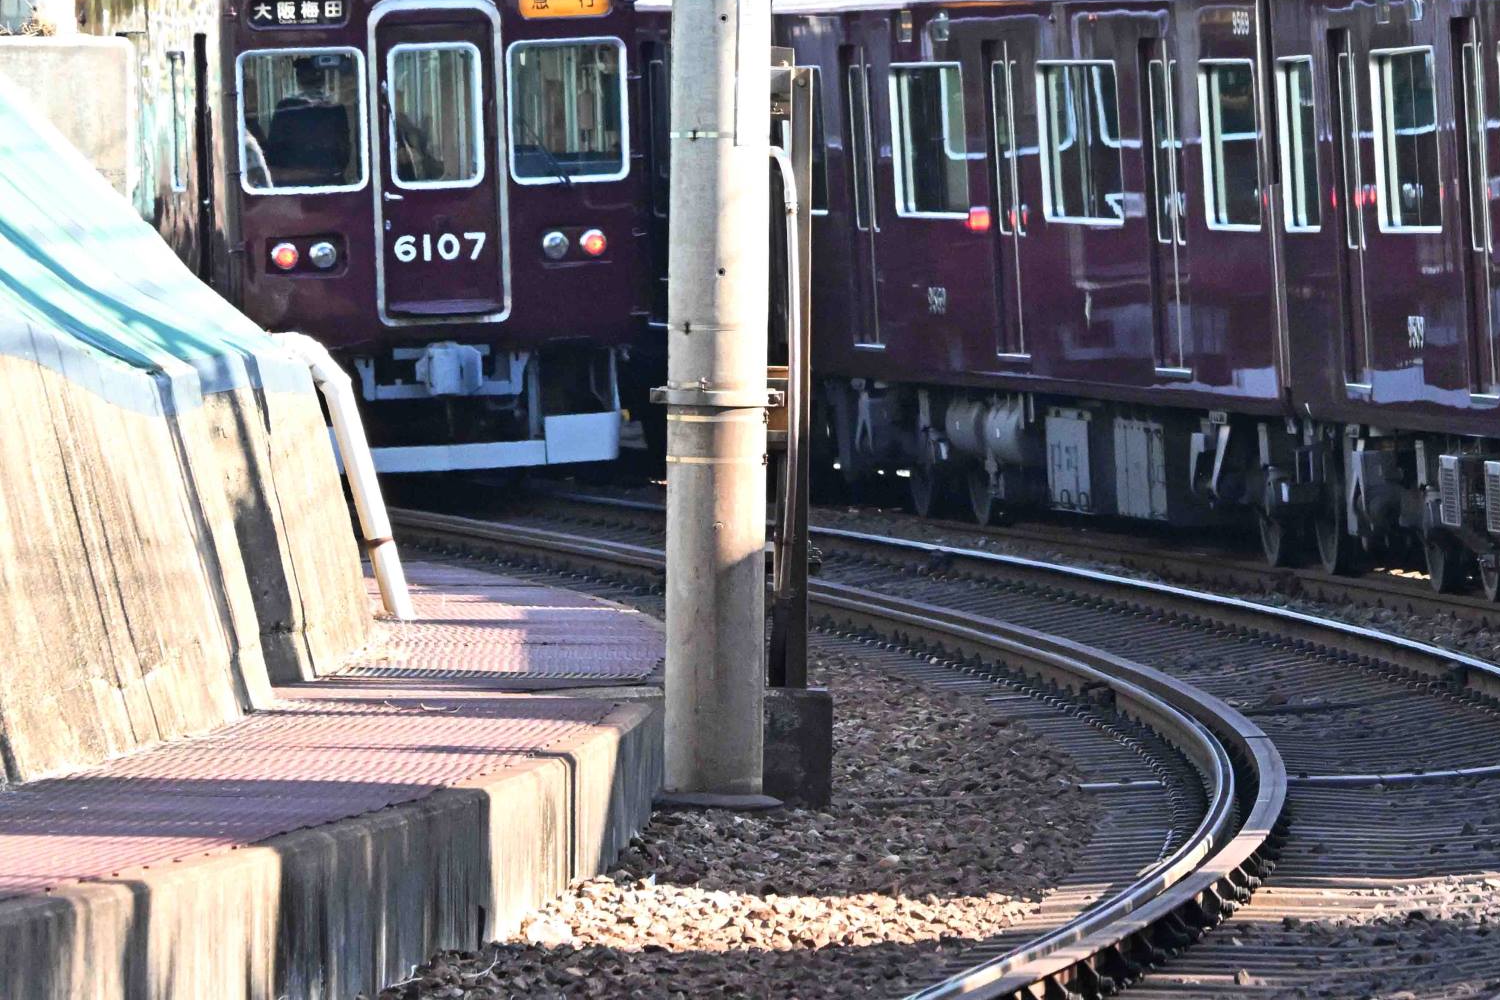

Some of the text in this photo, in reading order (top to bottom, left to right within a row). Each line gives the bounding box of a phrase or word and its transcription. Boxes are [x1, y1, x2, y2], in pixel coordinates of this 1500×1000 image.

[253, 0, 342, 20] 大阪梅田
[394, 232, 486, 262] 6107
